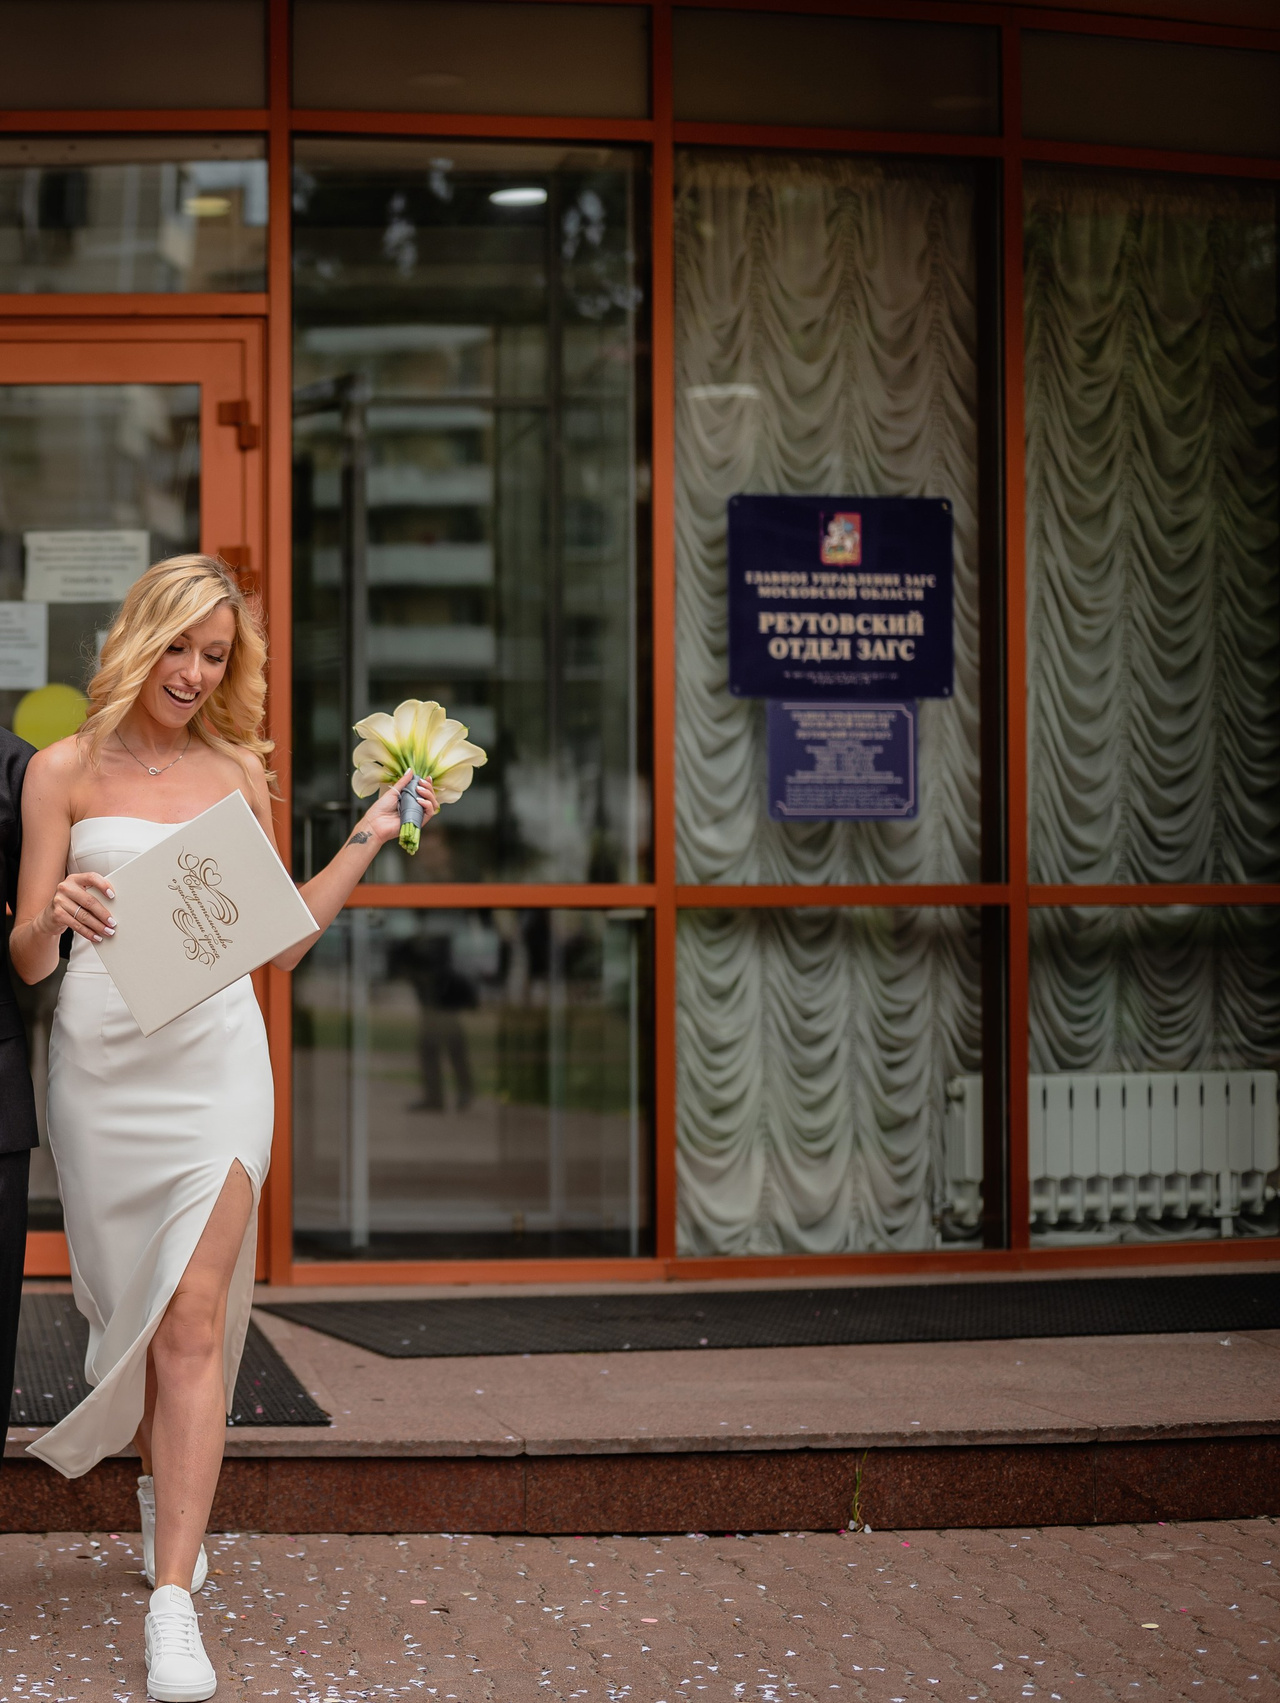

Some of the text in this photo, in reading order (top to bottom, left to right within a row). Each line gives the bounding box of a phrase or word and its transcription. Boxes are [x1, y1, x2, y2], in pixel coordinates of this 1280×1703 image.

[745, 571, 936, 588] ГЛАВНОЕ УПРАВЛЕНИЕ ЗАГС
[758, 586, 924, 600] МОСКОВСКОЙ ОБЛАСТИ
[759, 611, 924, 636] РЕУТОВСКИЙ
[768, 638, 915, 663] ОТДЕЛ ЗАГС
[168, 884, 206, 933] заключении
[198, 934, 221, 960] брака
[183, 874, 233, 949] Свидетельство
